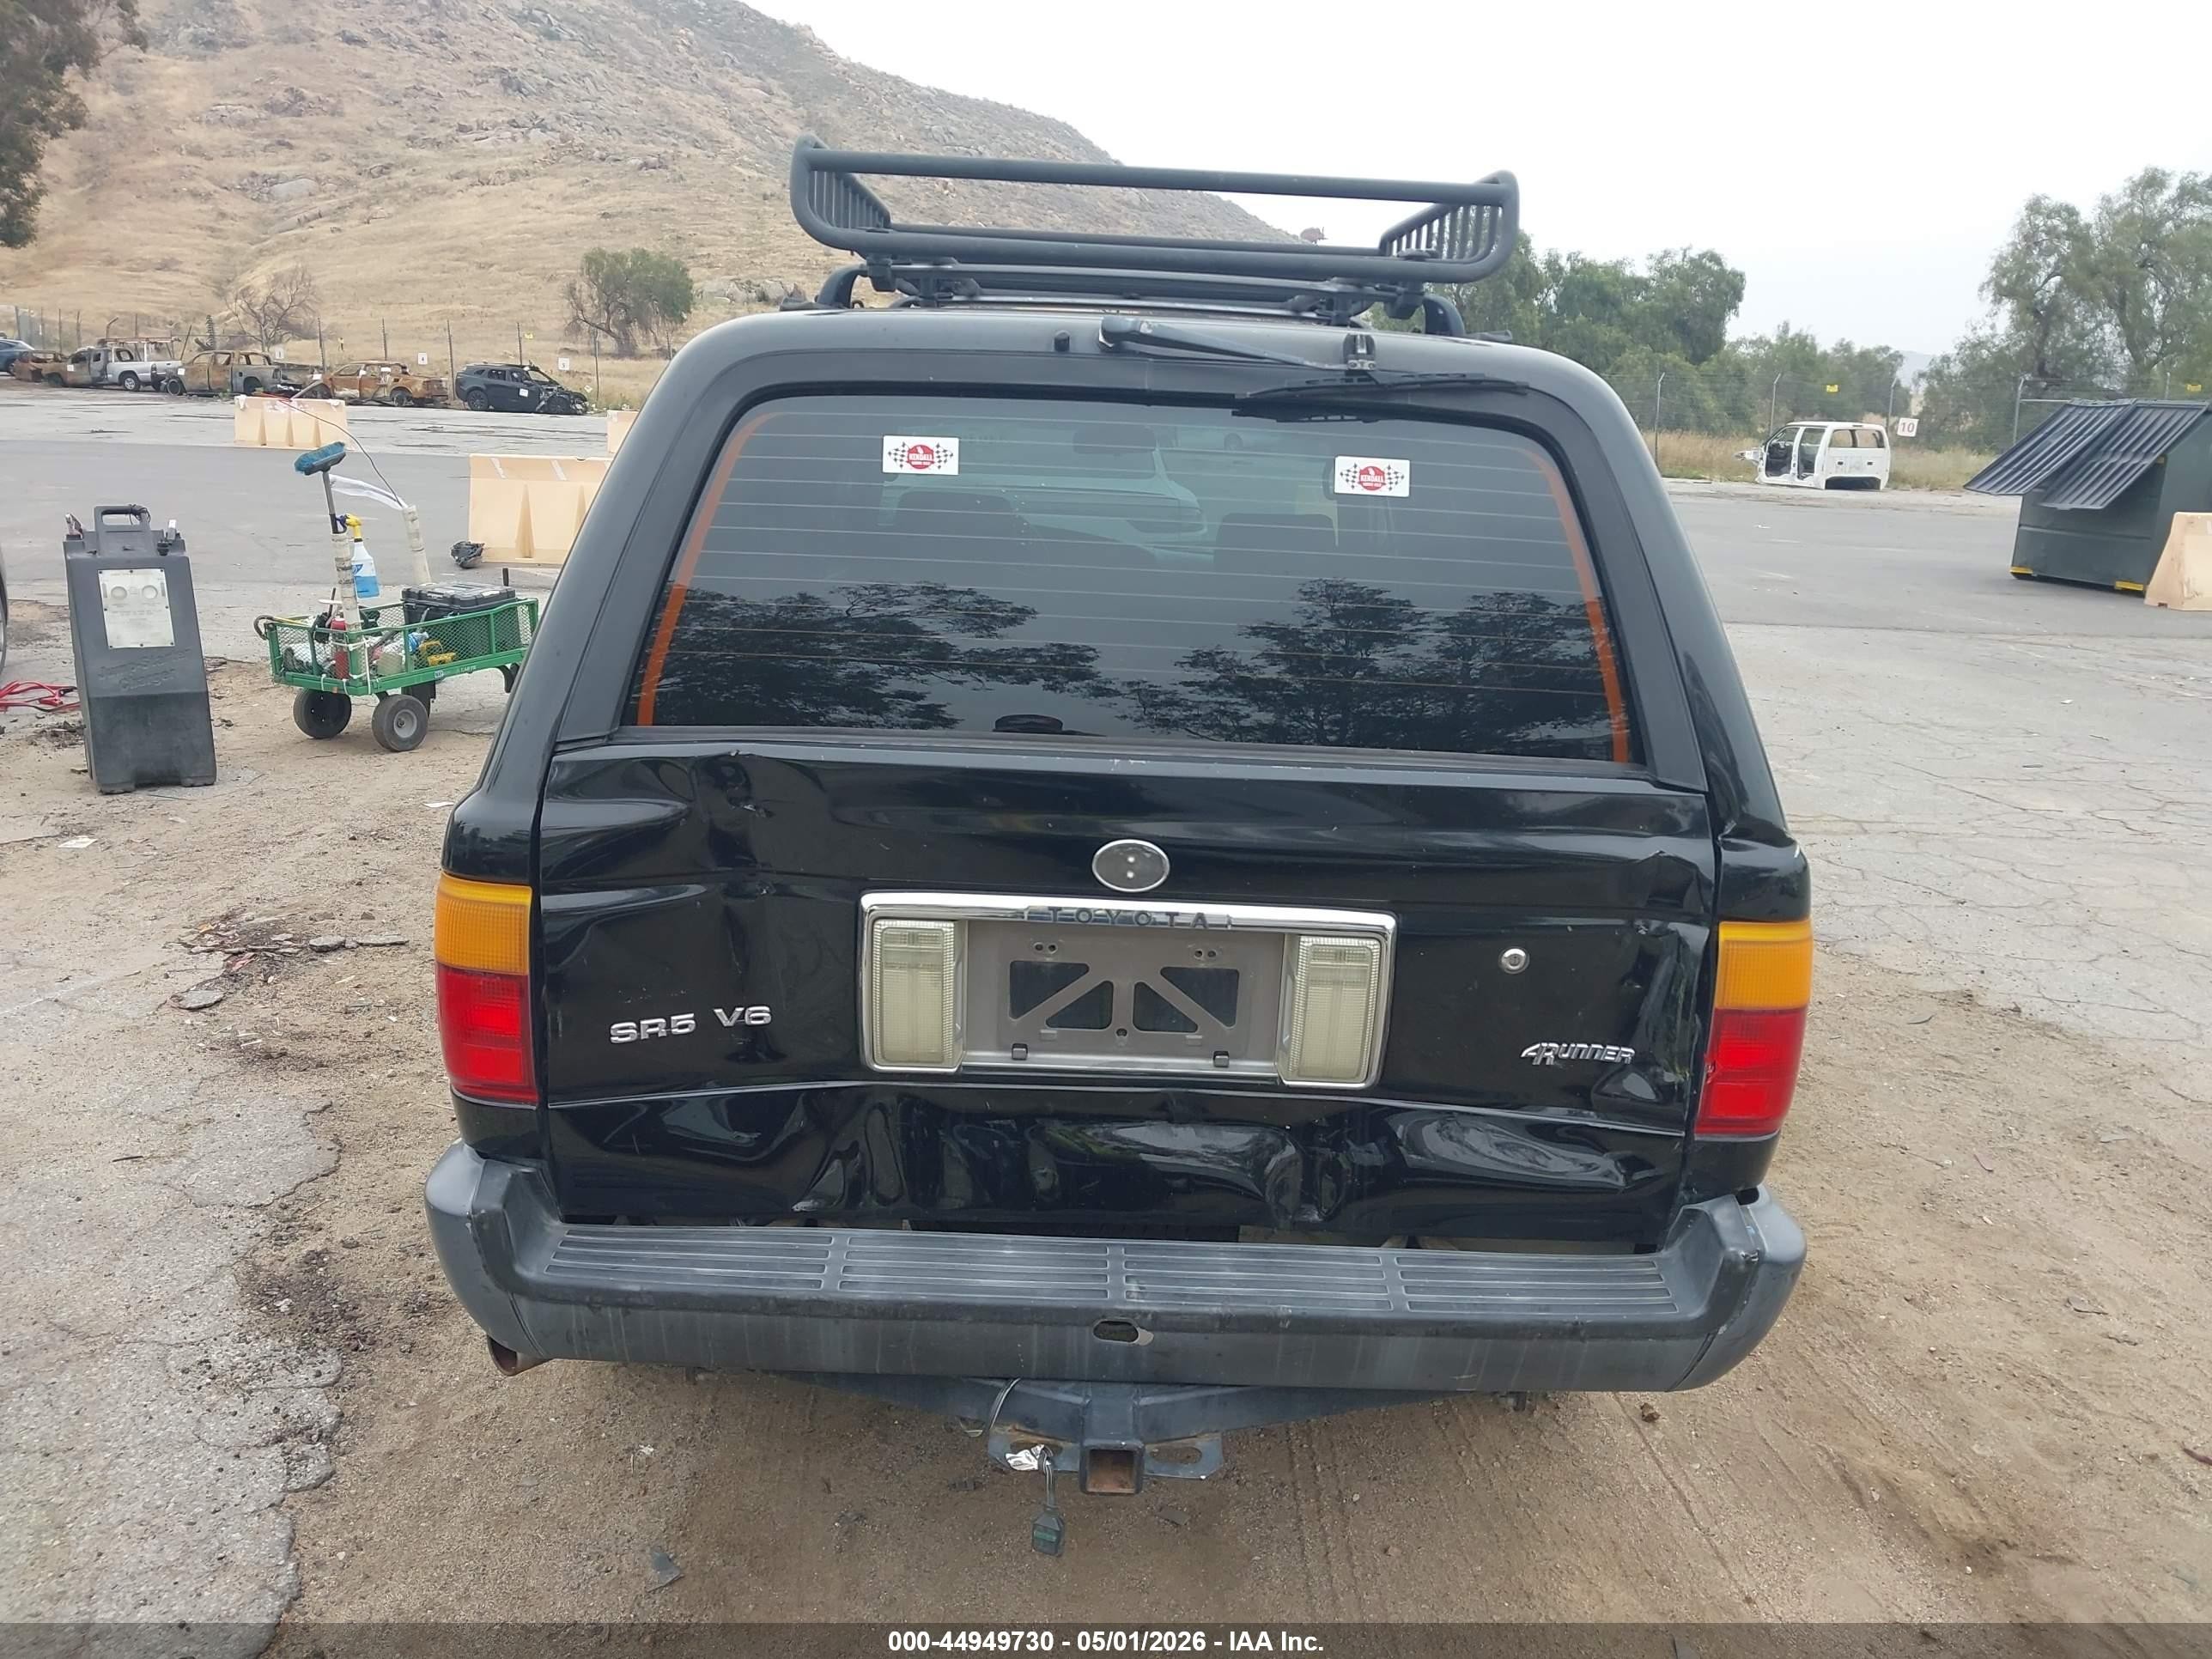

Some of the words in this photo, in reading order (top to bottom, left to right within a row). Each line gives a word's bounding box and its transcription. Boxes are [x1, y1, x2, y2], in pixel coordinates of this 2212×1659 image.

[1902, 422, 1915, 433] 10
[1048, 907, 1208, 928] TOYOTA
[610, 1012, 696, 1044] SR5
[713, 1006, 773, 1028] V6
[1521, 1042, 1635, 1065] 4RUNNER
